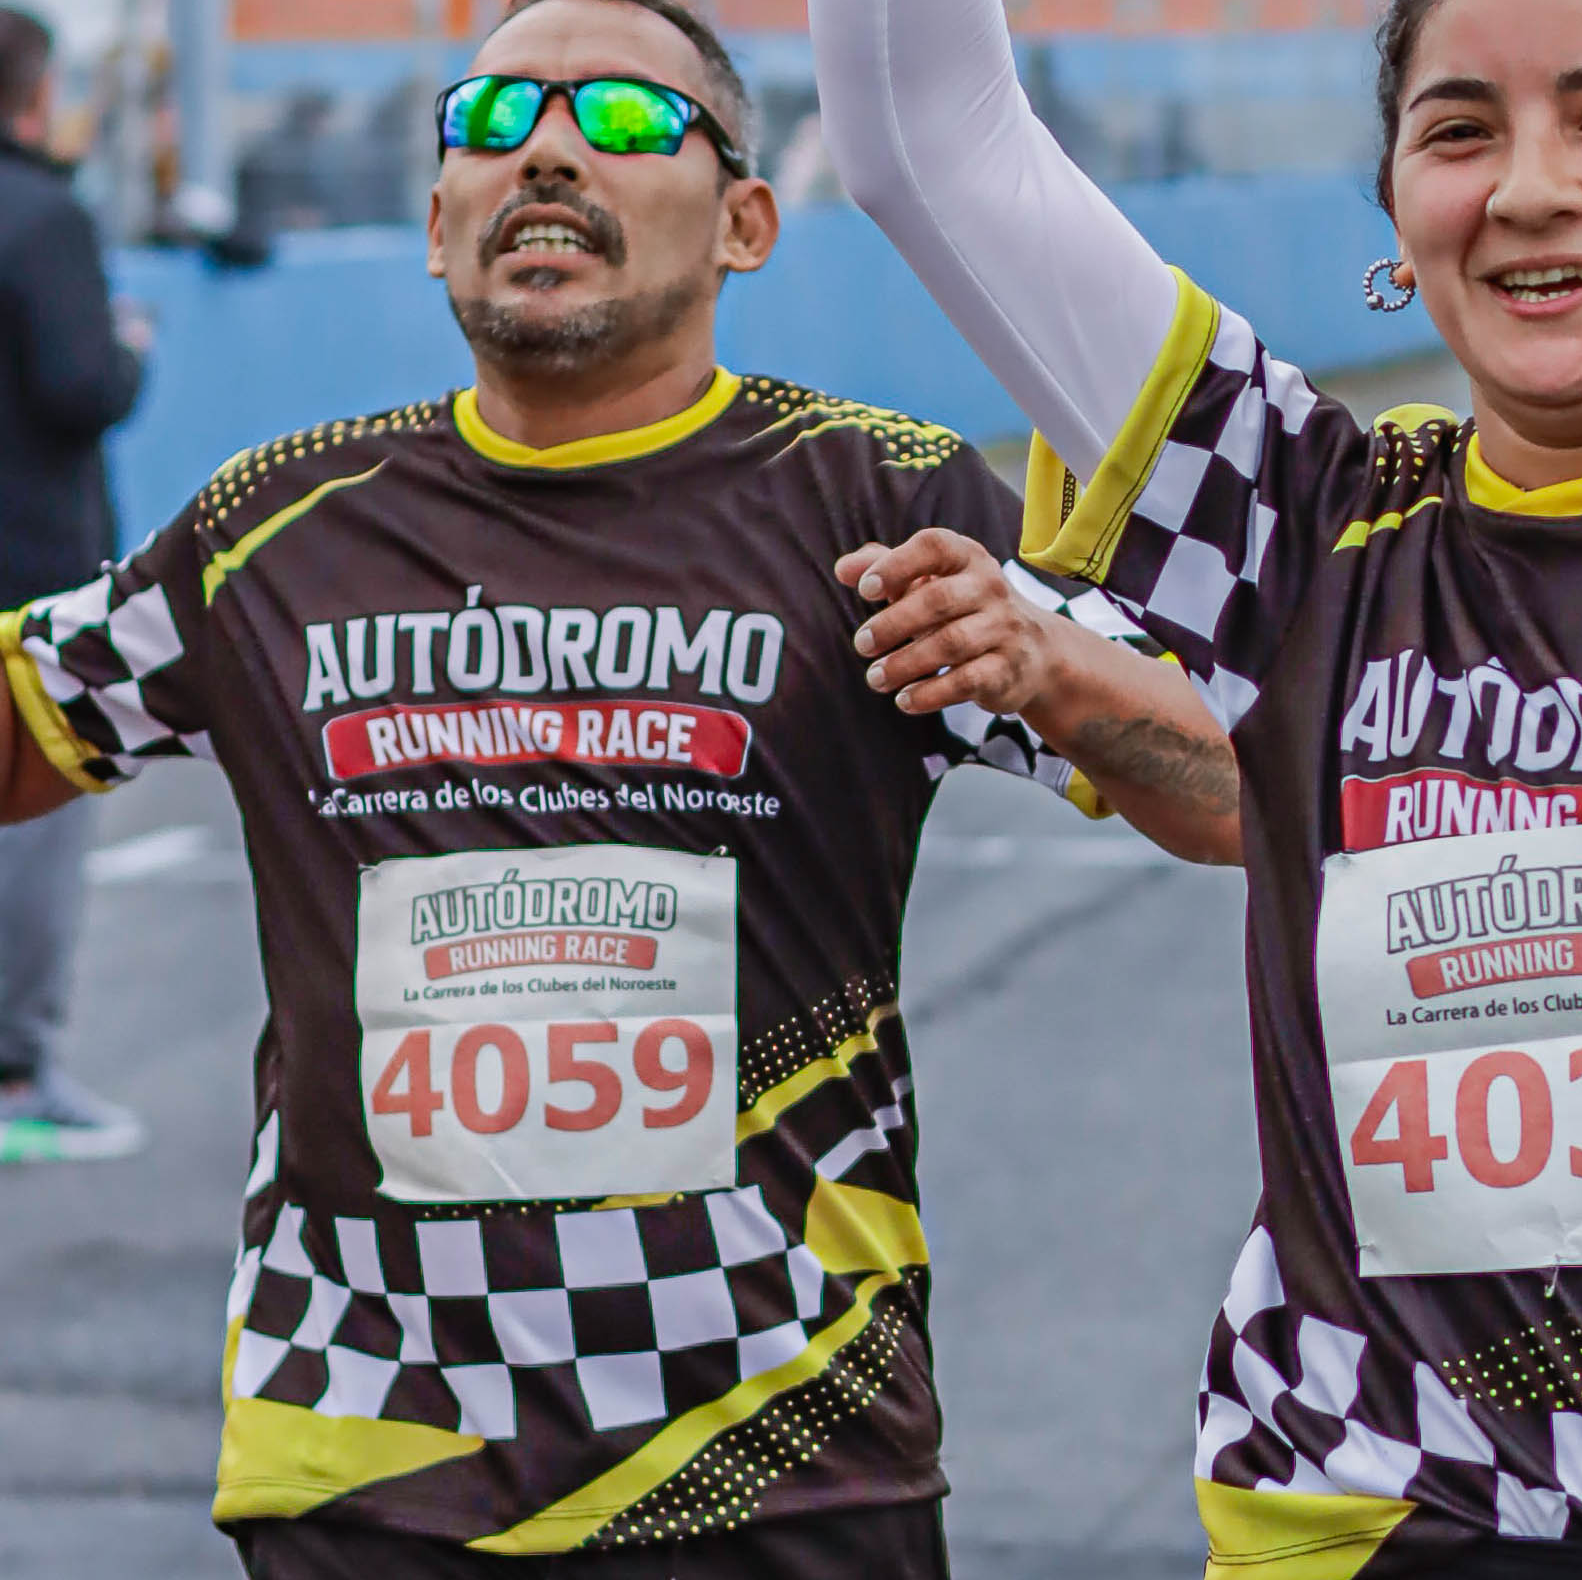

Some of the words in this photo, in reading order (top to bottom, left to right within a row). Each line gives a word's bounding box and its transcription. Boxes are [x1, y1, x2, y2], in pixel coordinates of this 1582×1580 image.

[303, 584, 785, 712] AUTÓDROMO
[365, 706, 564, 767] RUNNING
[575, 708, 697, 763] RACE
[333, 785, 428, 816] Carrera
[434, 780, 470, 810] de
[471, 777, 514, 808] los
[519, 783, 610, 814] Clubes
[614, 783, 656, 812] del
[1384, 779, 1578, 843] RUNNNG
[411, 868, 678, 946] AUTÓDROMO
[448, 934, 556, 972] RUNNING
[564, 934, 630, 965] RACE
[1438, 938, 1575, 991] RUNNING
[403, 987, 420, 1002] La
[422, 985, 476, 1001] Carrera
[479, 980, 499, 997] de
[502, 978, 524, 995] los
[527, 977, 579, 994] Clubes
[581, 976, 606, 992] del
[608, 977, 677, 992] Noroeste
[1386, 1008, 1408, 1026] La
[1411, 1005, 1480, 1025] Carrera
[1484, 998, 1508, 1018] de
[1512, 996, 1540, 1016] los
[370, 1018, 716, 1139] 4059
